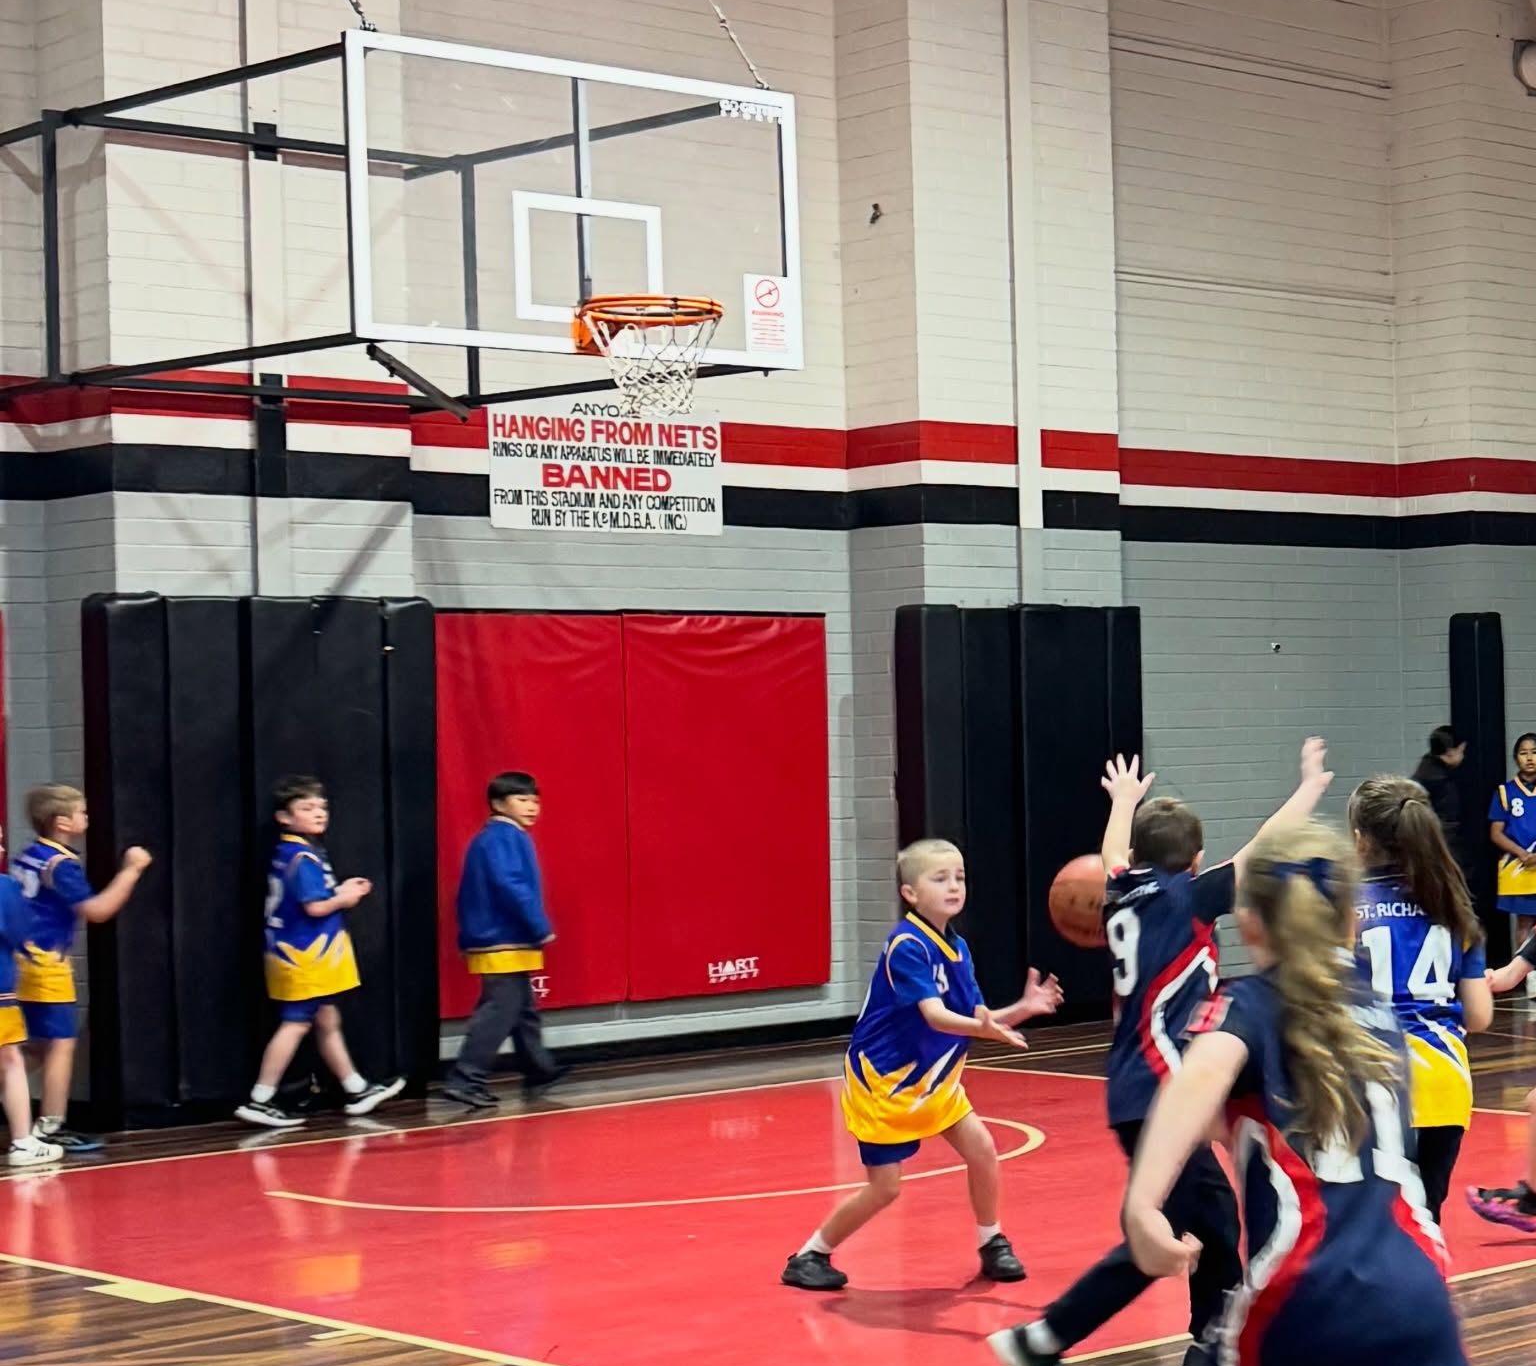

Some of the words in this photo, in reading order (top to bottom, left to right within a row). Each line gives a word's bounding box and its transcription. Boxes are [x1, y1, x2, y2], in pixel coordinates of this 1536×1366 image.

[571, 402, 636, 418] ANYO
[493, 413, 585, 442] HANGING
[591, 419, 654, 446] FROM
[658, 423, 718, 450] NETS
[493, 441, 523, 458] RINGS
[525, 443, 538, 459] OR
[540, 444, 558, 460] ANY
[560, 445, 611, 463] APPARATUS
[613, 448, 636, 464] WILL
[637, 449, 650, 465] BE
[653, 450, 717, 468] IMMEDIATELY
[542, 463, 672, 492] BANNED
[494, 488, 522, 505] FROM
[523, 490, 548, 506] THIS
[551, 491, 595, 508] STADIUM
[599, 493, 620, 509] AND
[622, 493, 643, 510] ANY
[646, 495, 715, 512] COMPETITION
[531, 508, 551, 526] RUN
[555, 509, 567, 527] BY
[569, 510, 590, 527] THE
[1511, 797, 1525, 817] 8
[1376, 902, 1424, 917] RICHA
[1106, 907, 1141, 996] 9
[708, 957, 759, 976] HART
[1361, 924, 1455, 1006] 14
